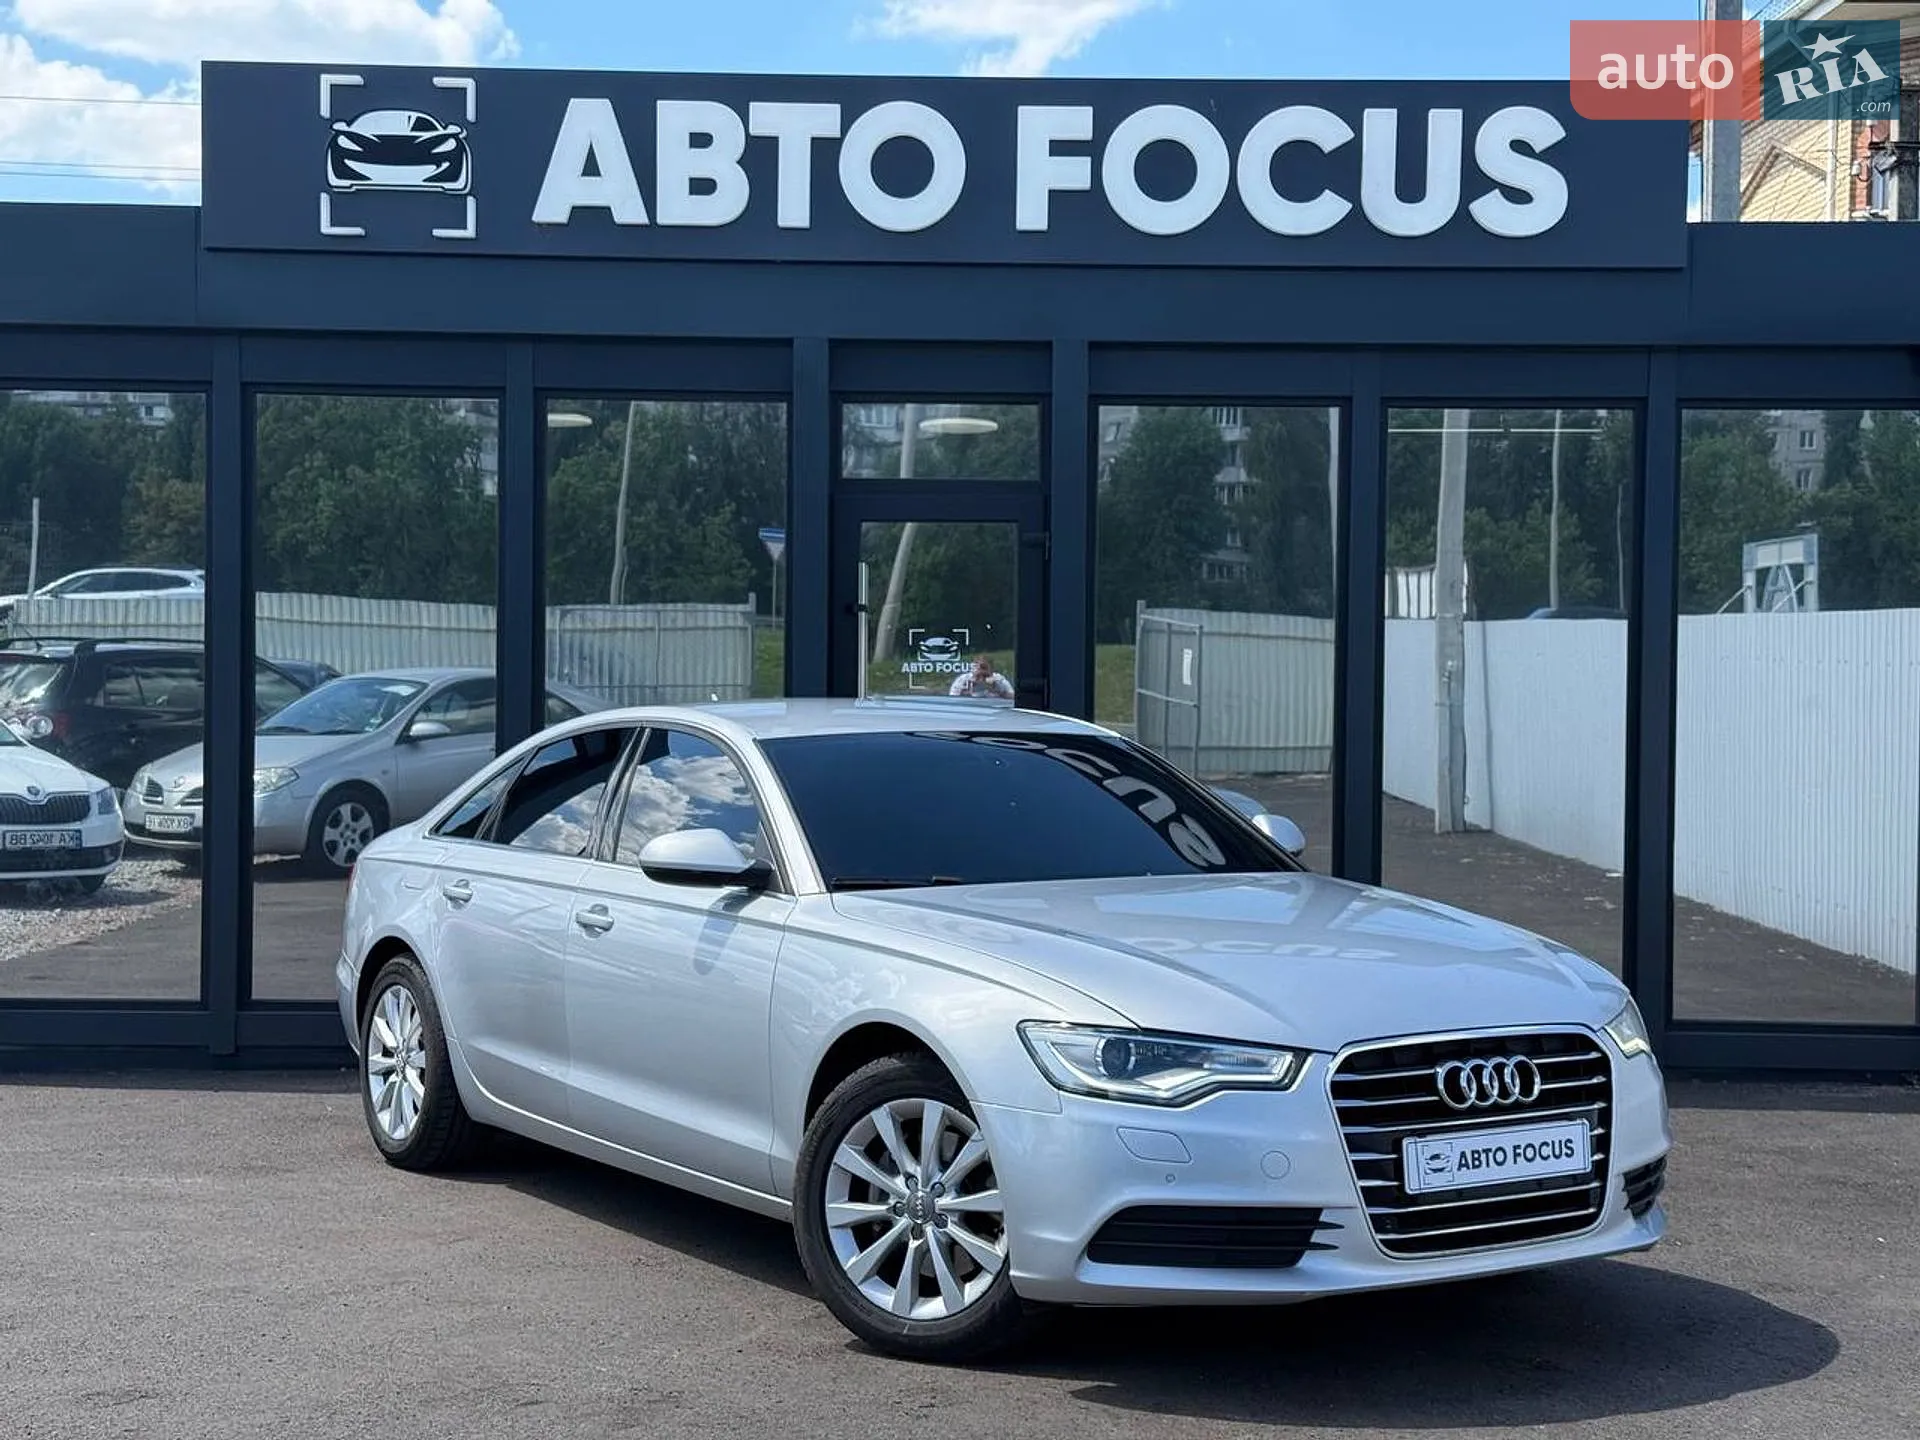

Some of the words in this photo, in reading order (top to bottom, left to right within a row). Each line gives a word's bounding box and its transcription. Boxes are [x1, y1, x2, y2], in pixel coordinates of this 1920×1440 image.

[531, 98, 967, 233] АВТО
[1015, 104, 1569, 238] FOCUS
[902, 662, 934, 673] АВТО
[936, 662, 977, 673] FOCUS
[1457, 1146, 1507, 1171] АВТО
[1512, 1138, 1575, 1165] FOCUS
